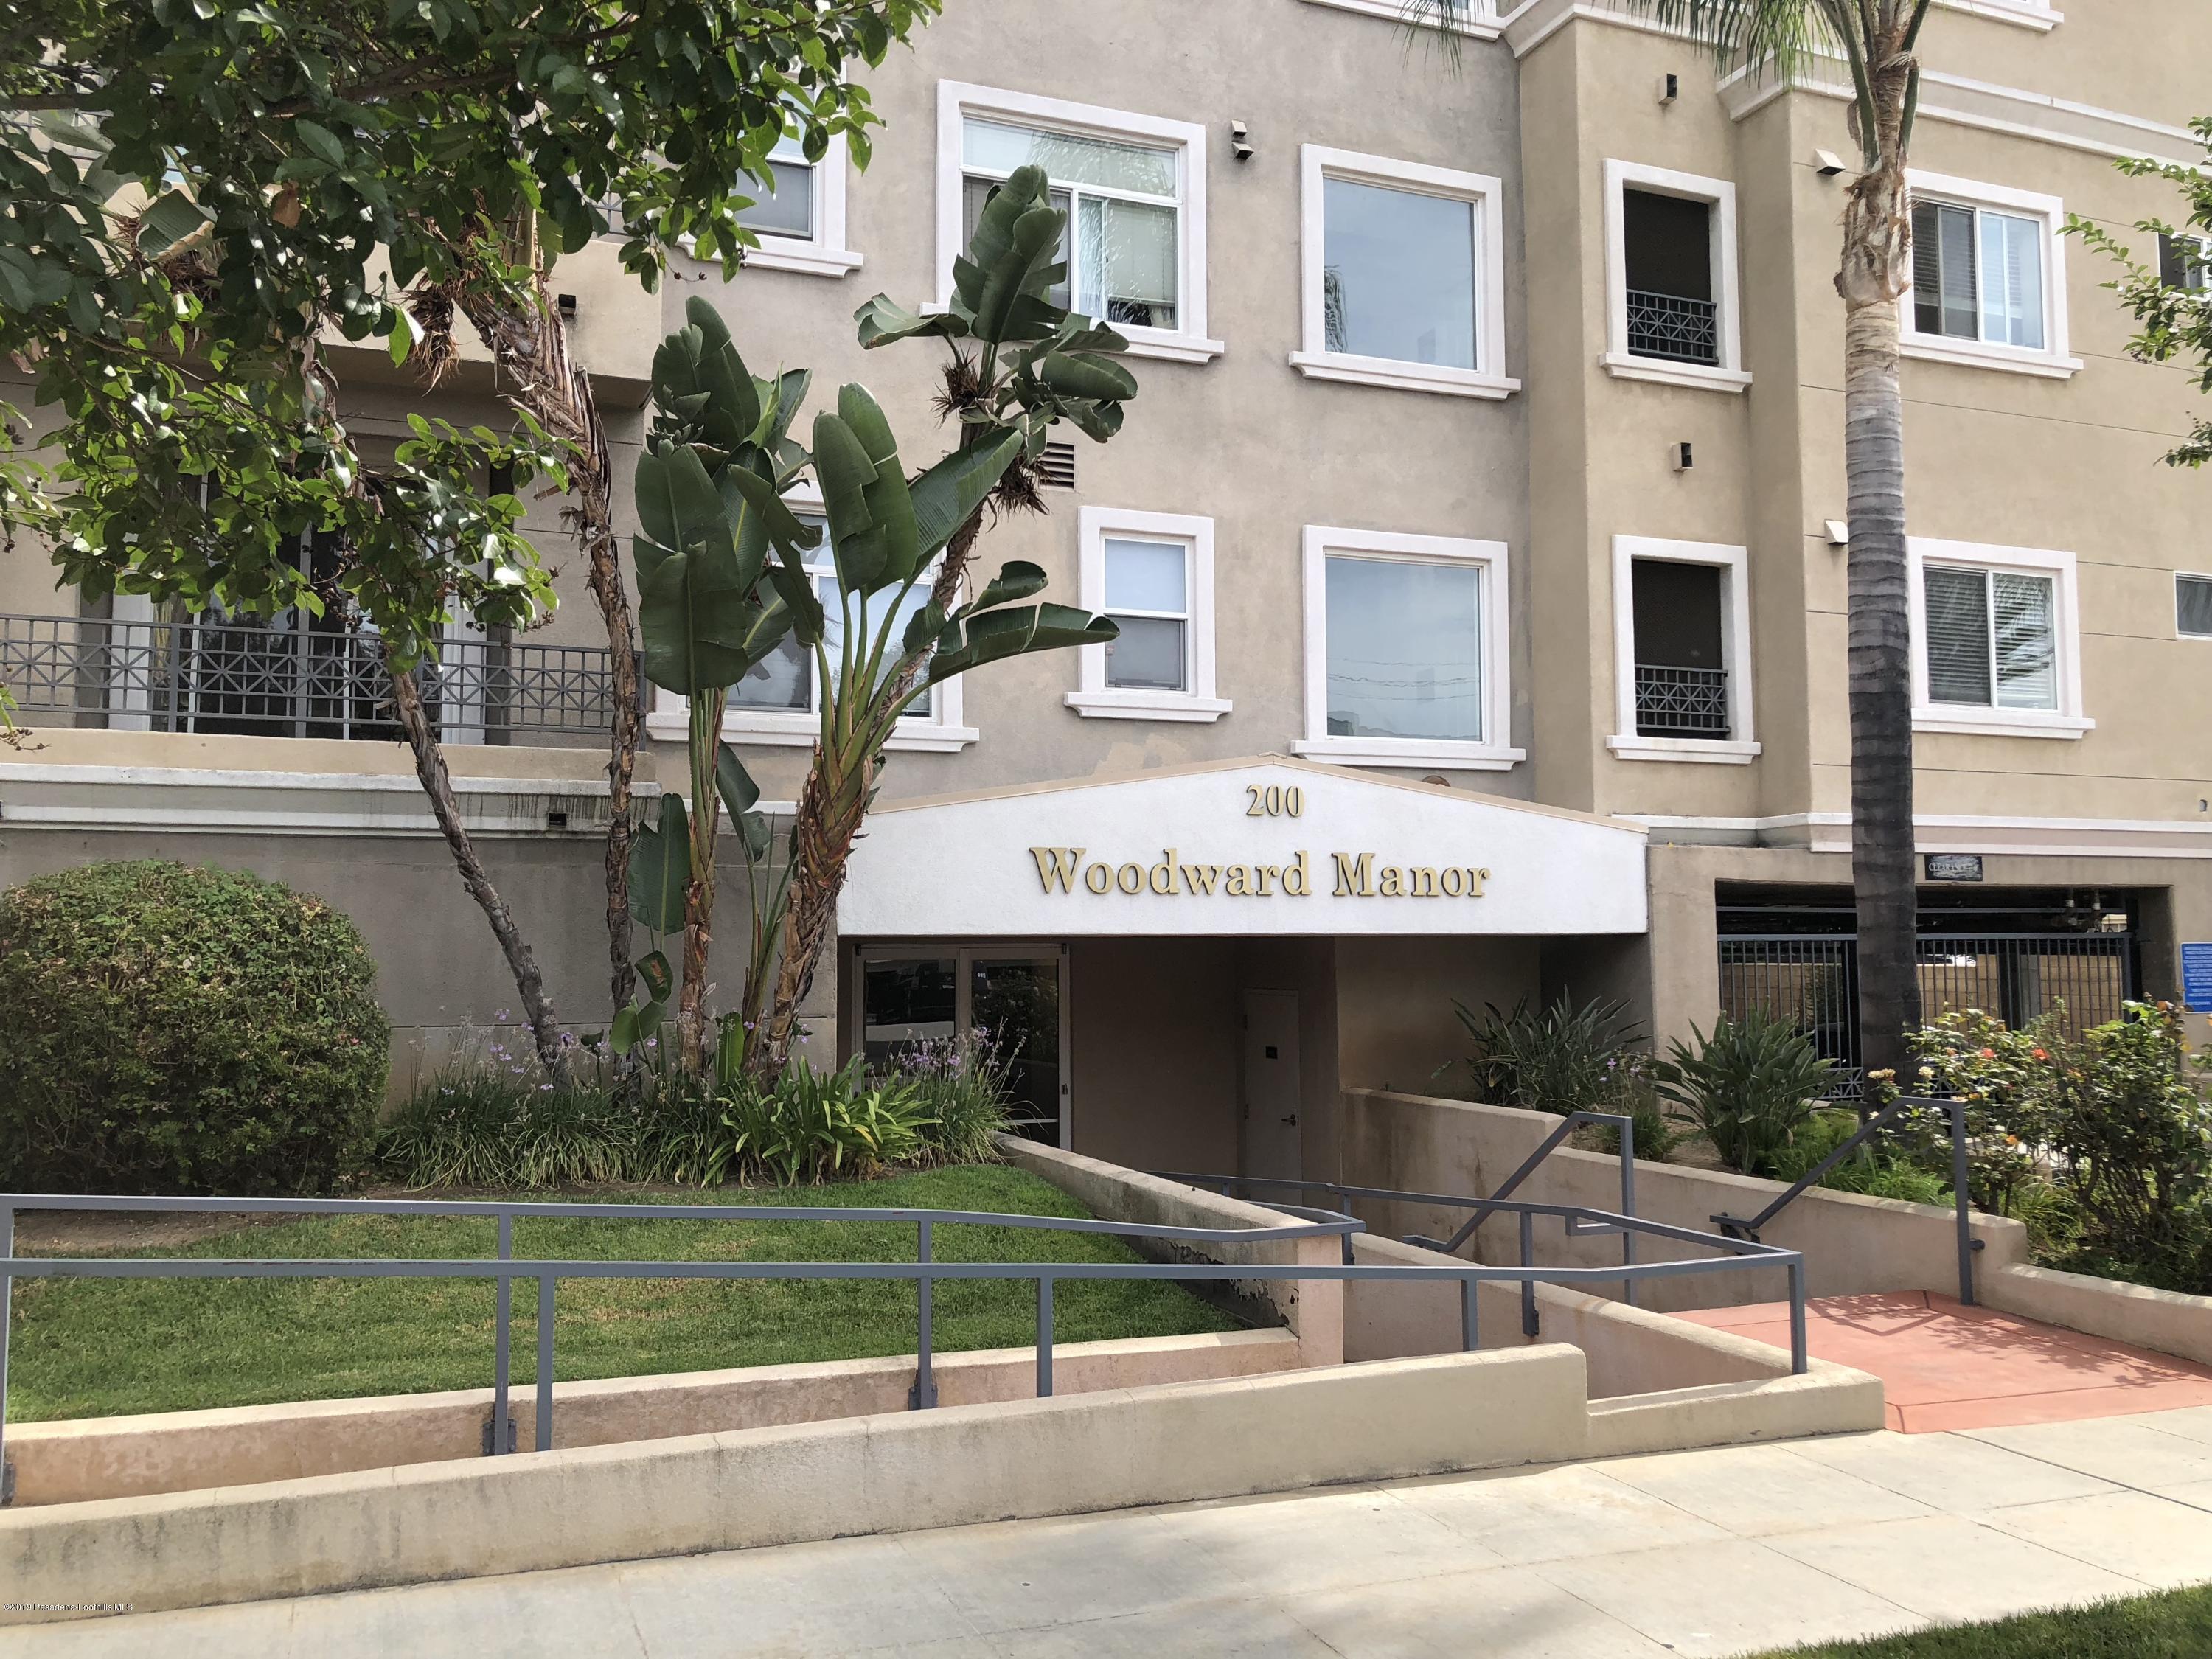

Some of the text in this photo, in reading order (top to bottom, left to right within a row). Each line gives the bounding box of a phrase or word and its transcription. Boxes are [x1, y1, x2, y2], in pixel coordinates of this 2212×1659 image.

[1246, 784, 1304, 817] 200
[1029, 846, 1492, 897] Woodward Manor
